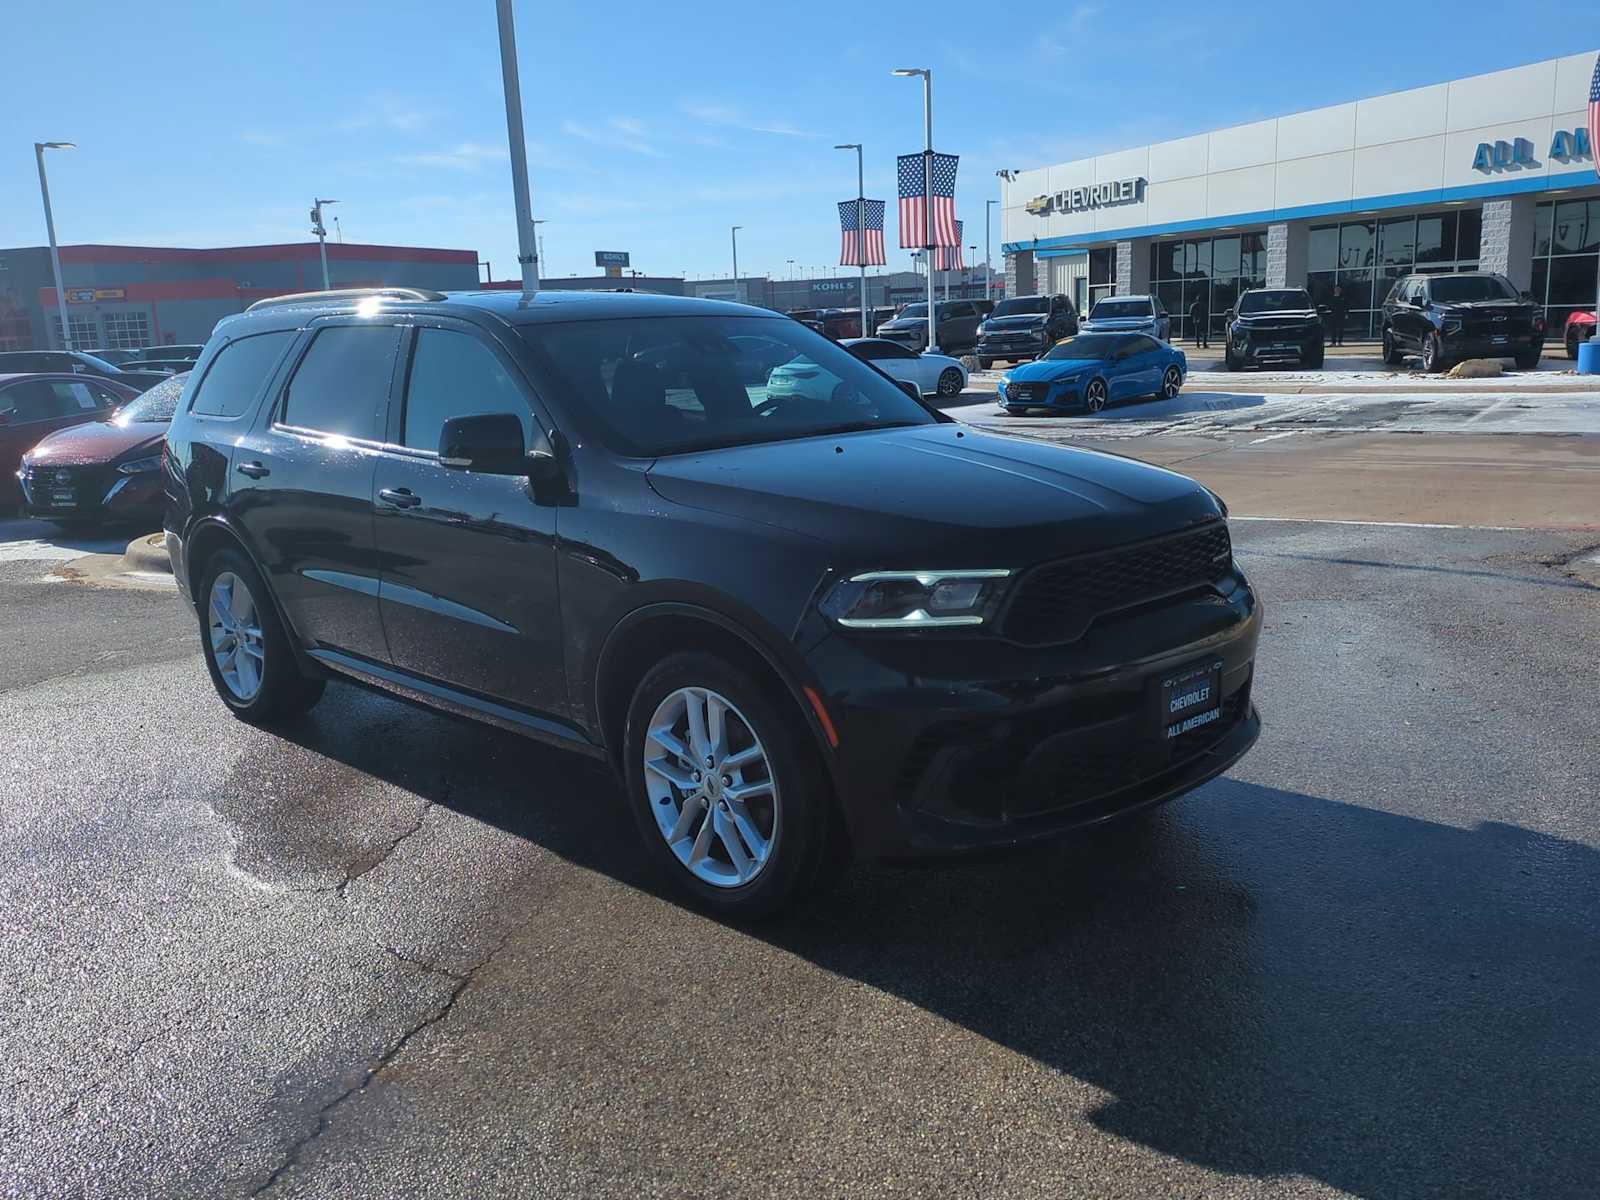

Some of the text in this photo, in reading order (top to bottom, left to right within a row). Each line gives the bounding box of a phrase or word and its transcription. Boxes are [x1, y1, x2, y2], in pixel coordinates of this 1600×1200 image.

[1472, 137, 1537, 172] ALL
[1053, 176, 1141, 212] CHEVROLET
[1170, 687, 1210, 713] CHEVROLET
[1167, 707, 1220, 739] ALL AMERICAN
